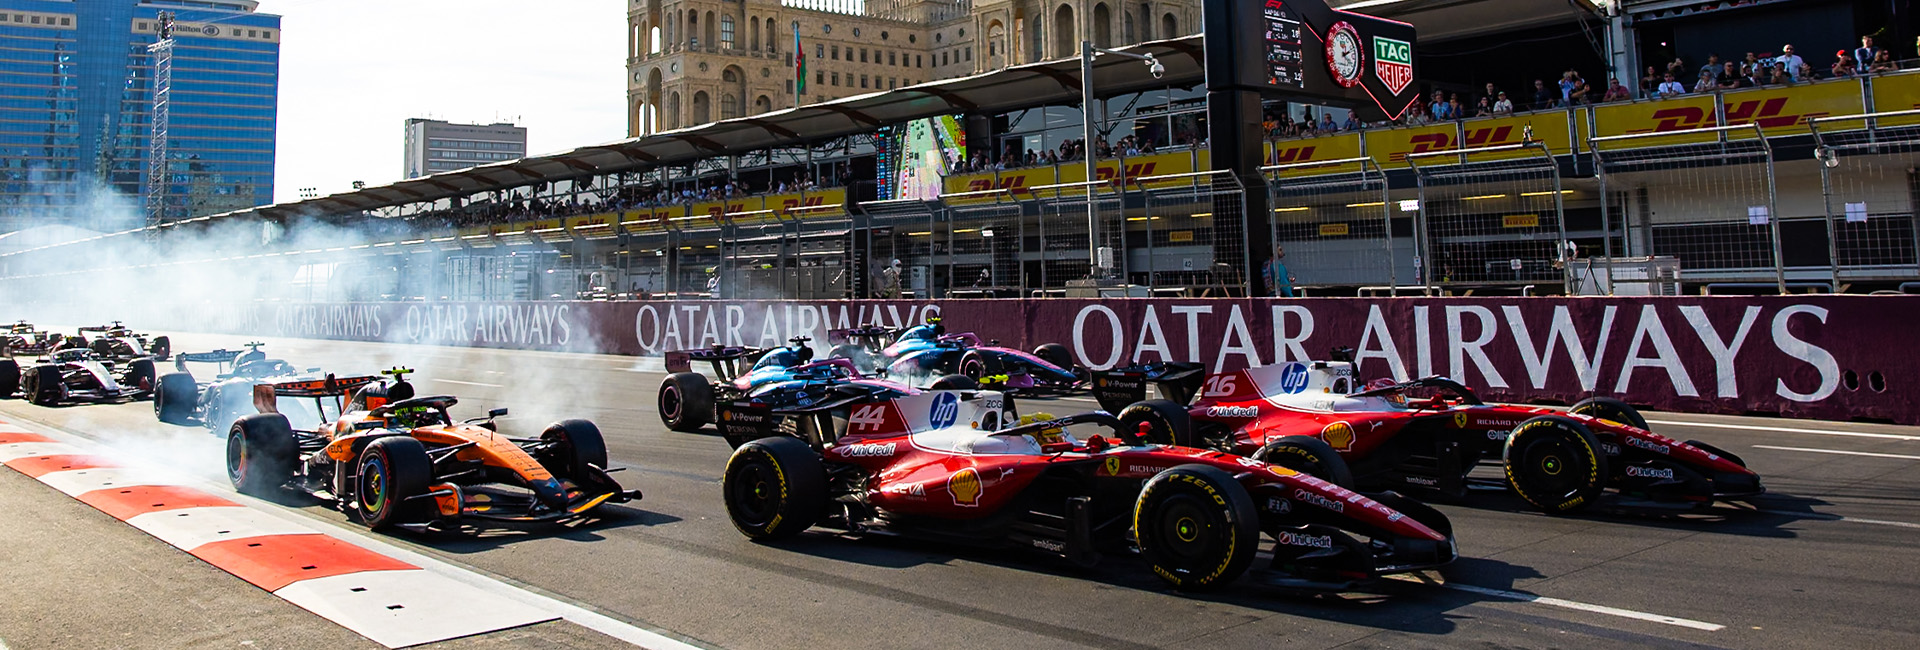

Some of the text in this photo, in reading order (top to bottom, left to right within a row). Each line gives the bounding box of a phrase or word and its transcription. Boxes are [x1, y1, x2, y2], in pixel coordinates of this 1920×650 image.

[176, 24, 201, 34] Hilton
[1377, 41, 1408, 61] TAG
[1379, 63, 1411, 93] HEUER
[1652, 97, 1799, 132] DHL
[1408, 125, 1524, 158] DHL
[1094, 162, 1162, 186] DHL
[967, 176, 1035, 198] DHL
[707, 204, 746, 220] DHL
[783, 196, 826, 214] DHL
[275, 304, 317, 336] QATAR
[320, 304, 381, 338] AIRWAYS
[406, 304, 570, 346] QATAR AIRWAYS
[635, 304, 746, 353] QATAR
[1072, 304, 1840, 402] QATAR AIRWAYS
[1107, 380, 1138, 388] V-Power
[1204, 375, 1236, 397] 16
[1283, 363, 1307, 395] hp
[932, 392, 956, 430] hp
[985, 400, 1002, 408] ZCG
[1218, 405, 1258, 417] UniCredit
[732, 412, 763, 422] V-Power
[849, 405, 886, 431] 44
[1476, 418, 1511, 426] RICHARD
[726, 424, 757, 433] PERONI
[852, 442, 896, 456] UniCredit
[1278, 445, 1319, 463] ZERO
[1602, 443, 1619, 453] FIA
[1634, 438, 1670, 454] UniCredit
[1637, 467, 1673, 479] UniCredit
[1168, 474, 1226, 505] P ZERO
[1268, 499, 1289, 511] FIA
[1305, 491, 1344, 513] UniCredit
[1290, 534, 1332, 548] UniCredit
